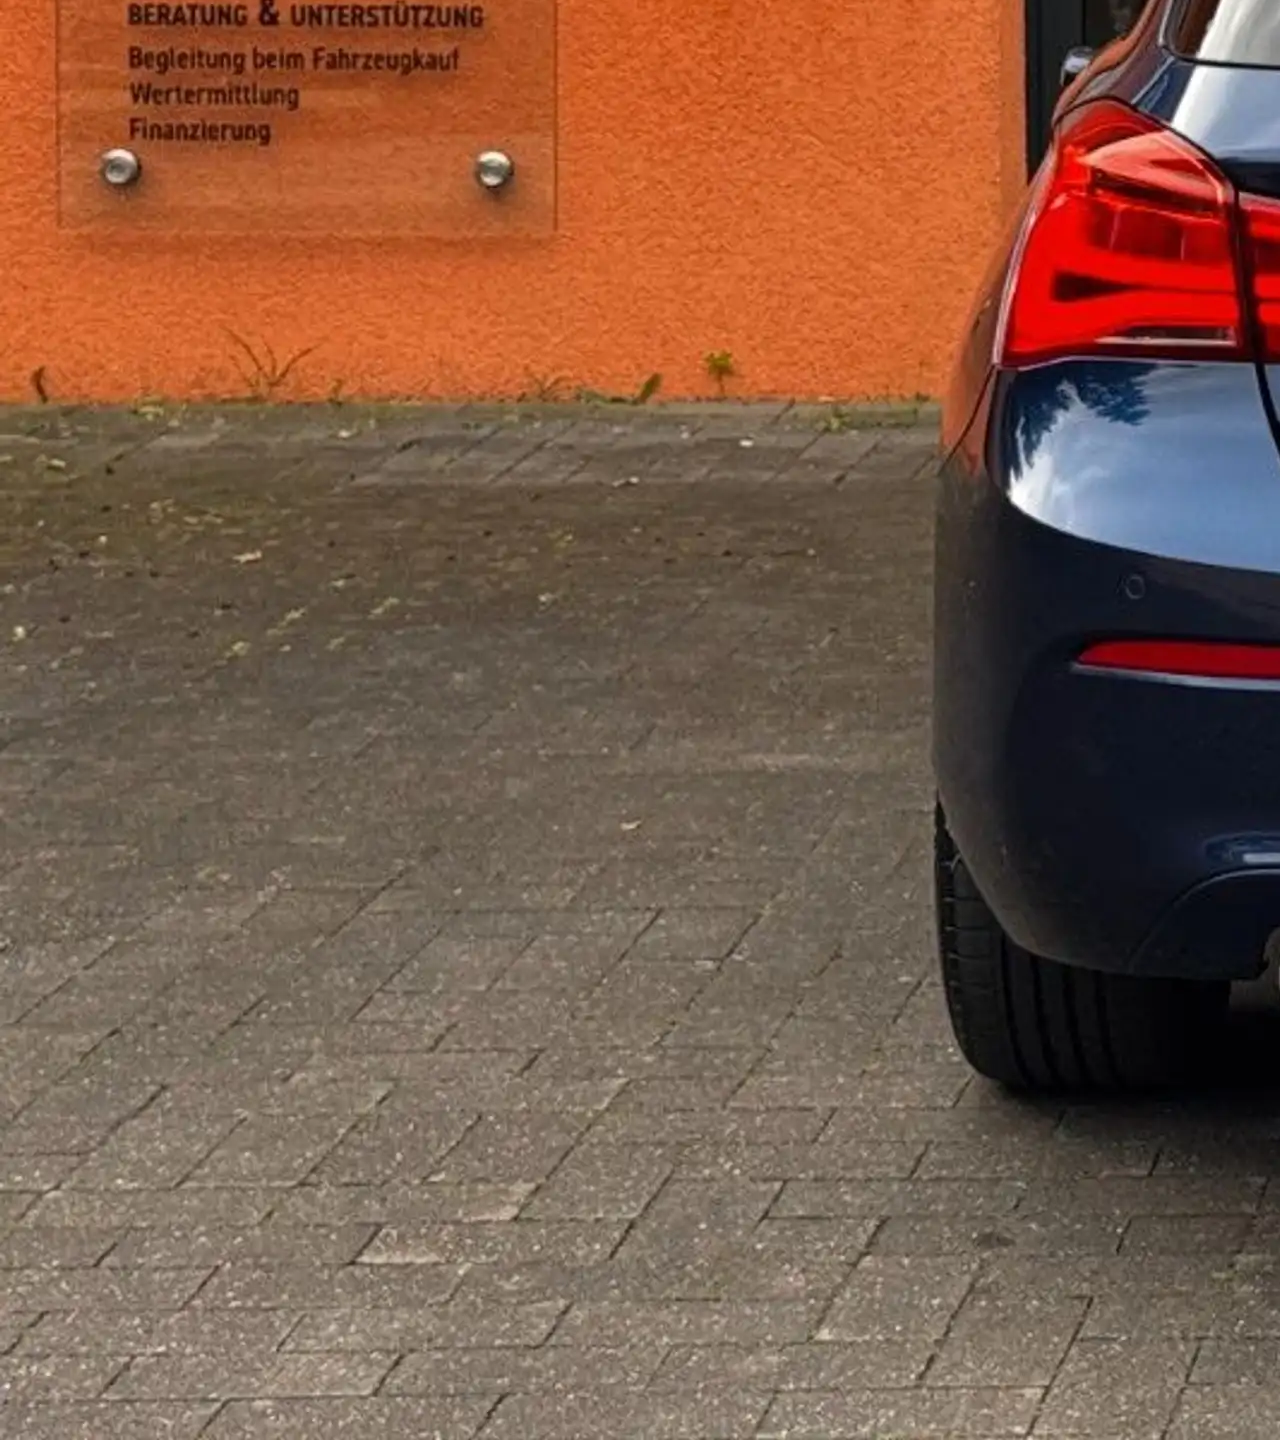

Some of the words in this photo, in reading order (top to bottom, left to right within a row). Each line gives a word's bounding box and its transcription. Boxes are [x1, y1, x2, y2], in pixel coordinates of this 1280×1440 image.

[128, 3, 247, 27] BERATUNG
[291, 1, 484, 29] UNTERSTÜTZUNG
[129, 47, 245, 75] Begleitung
[253, 48, 304, 70] beim
[313, 47, 460, 76] Fahrzeugkauf
[130, 84, 299, 111] Wertermittlung
[129, 118, 271, 146] Finanzierung
